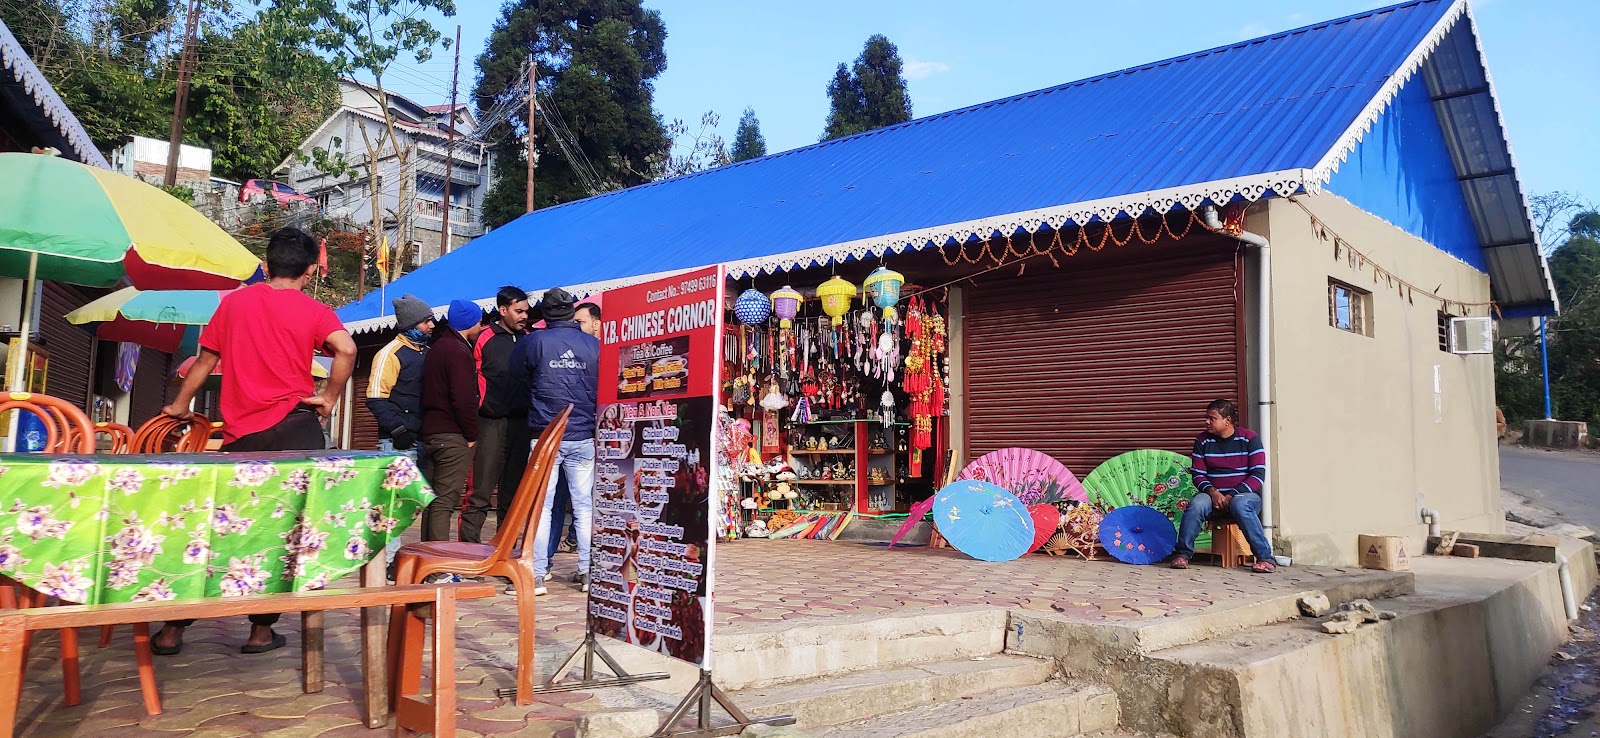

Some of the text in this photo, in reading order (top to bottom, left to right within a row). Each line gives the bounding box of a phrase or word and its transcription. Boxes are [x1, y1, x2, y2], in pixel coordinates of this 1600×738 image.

[646, 287, 667, 303] Contact
[681, 279, 698, 295] 97499
[699, 274, 717, 291] 63116
[602, 299, 716, 345] Y.B. CHINESE CORNOR
[632, 343, 673, 359] Tea & Coffee
[549, 359, 586, 369] adidas
[646, 403, 661, 416] Non
[599, 430, 616, 439] Chicken
[643, 427, 679, 440] Chicken Chilly
[642, 444, 662, 454] Chicken
[641, 460, 679, 472] Chicken Wings
[641, 475, 656, 486] Onion
[639, 490, 650, 502] Veg
[595, 500, 637, 512] Chicken Fried Rice
[640, 506, 660, 518] Samosa
[639, 538, 648, 549] Veg
[648, 540, 667, 552] Cheese
[638, 555, 651, 567] Fried
[661, 557, 682, 571] Cheese
[637, 570, 657, 583] Chicken
[658, 573, 677, 587] Cheese
[590, 585, 609, 599] Chicken
[637, 585, 672, 602] Veg Sandwich
[635, 601, 671, 619] Egg Sandwich
[635, 617, 682, 640] Chicken Sandwich
